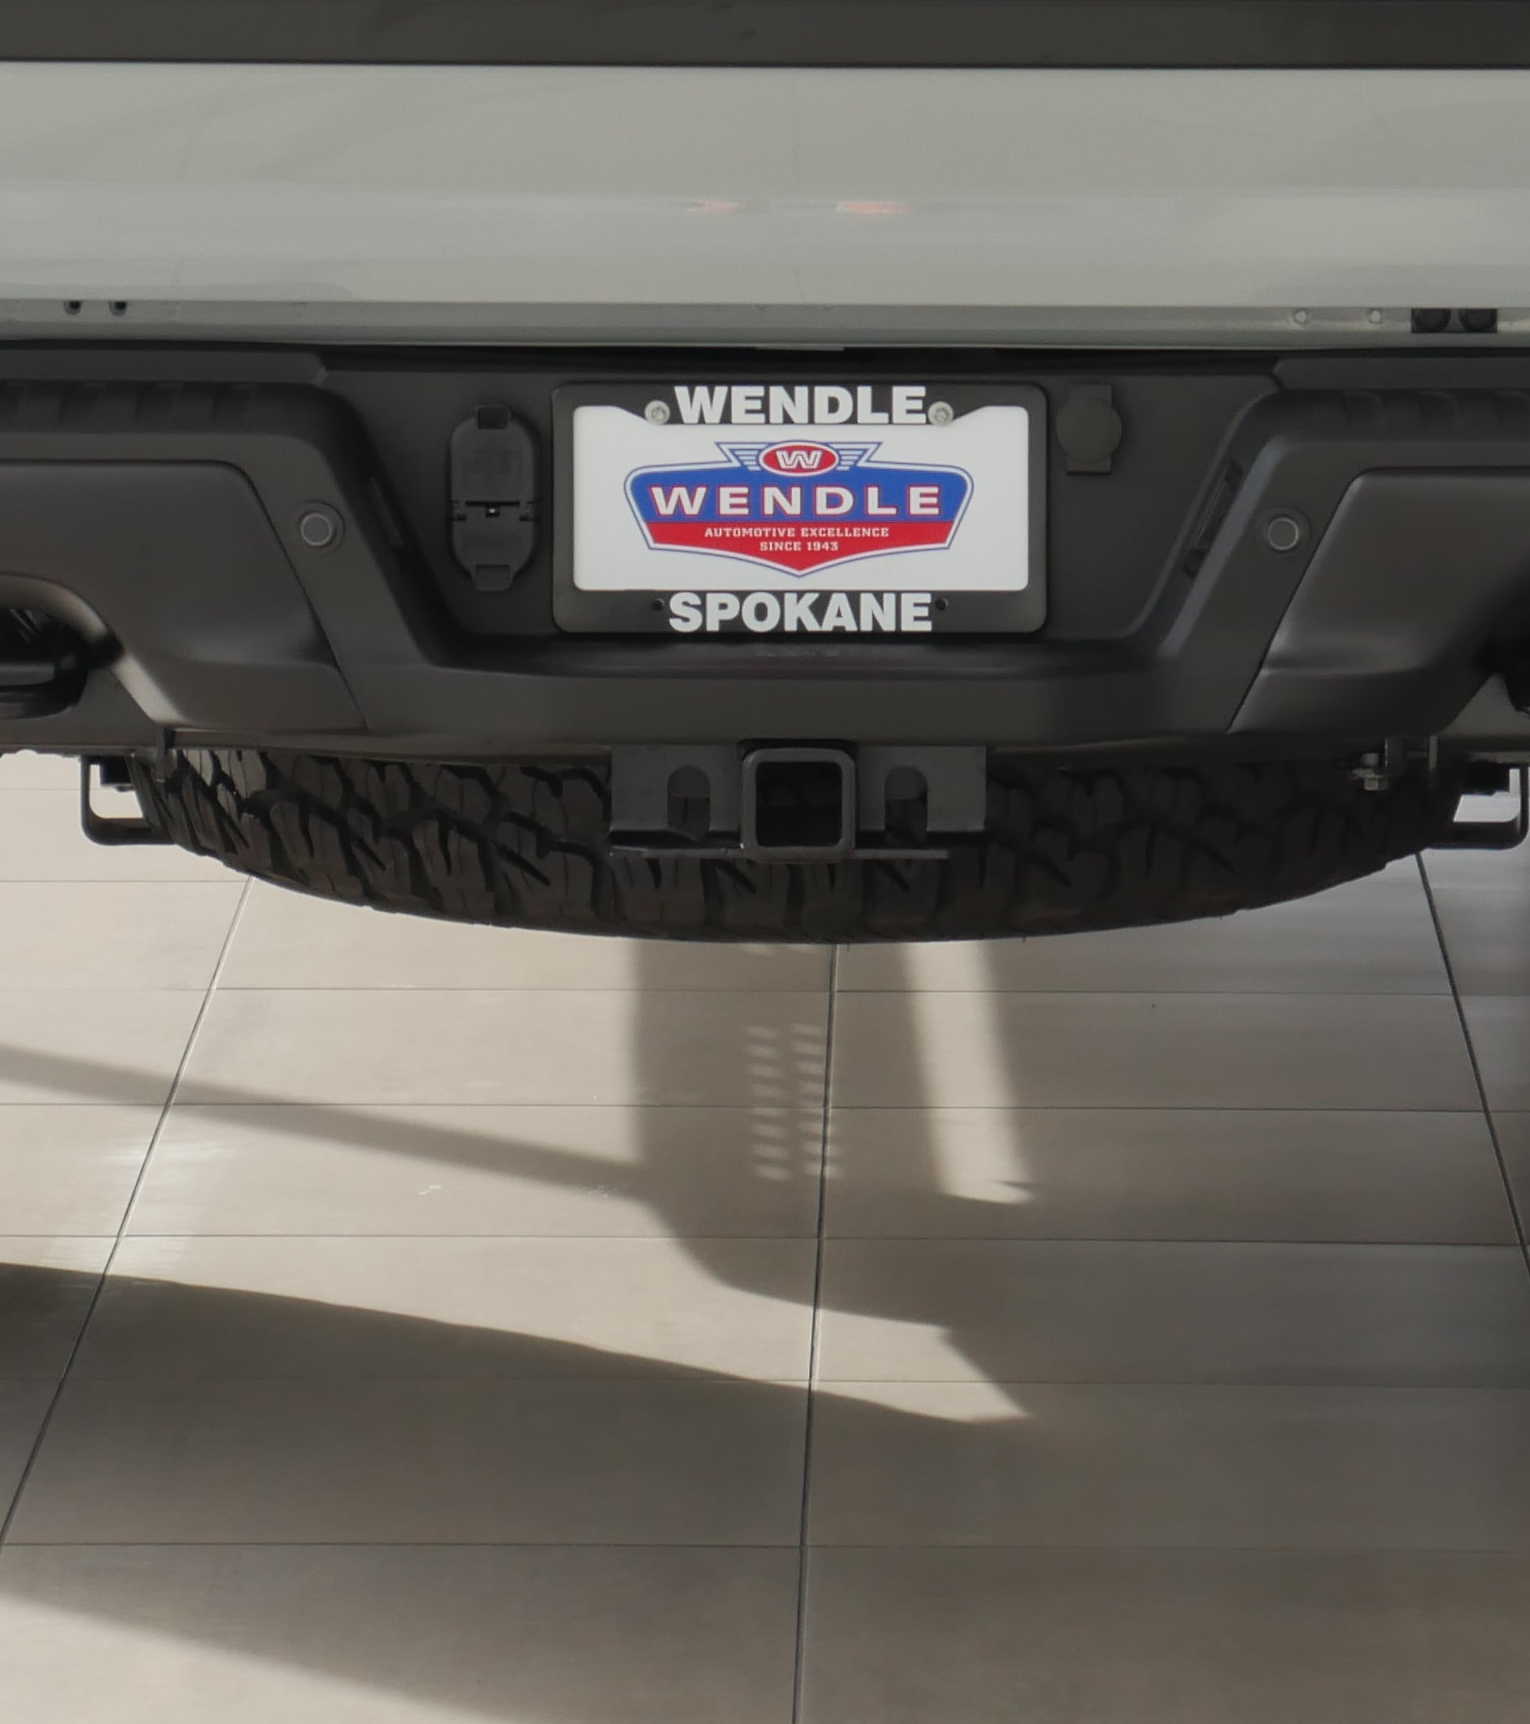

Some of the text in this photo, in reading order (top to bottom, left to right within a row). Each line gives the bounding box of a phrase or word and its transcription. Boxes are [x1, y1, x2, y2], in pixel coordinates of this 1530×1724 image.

[674, 385, 927, 425] WENDLE
[649, 485, 942, 517] WENDLE
[703, 526, 890, 538] AUTOMOTIVE EXCELLENCE
[758, 541, 840, 552] SINCE 1943
[668, 591, 934, 633] SPOKANE
